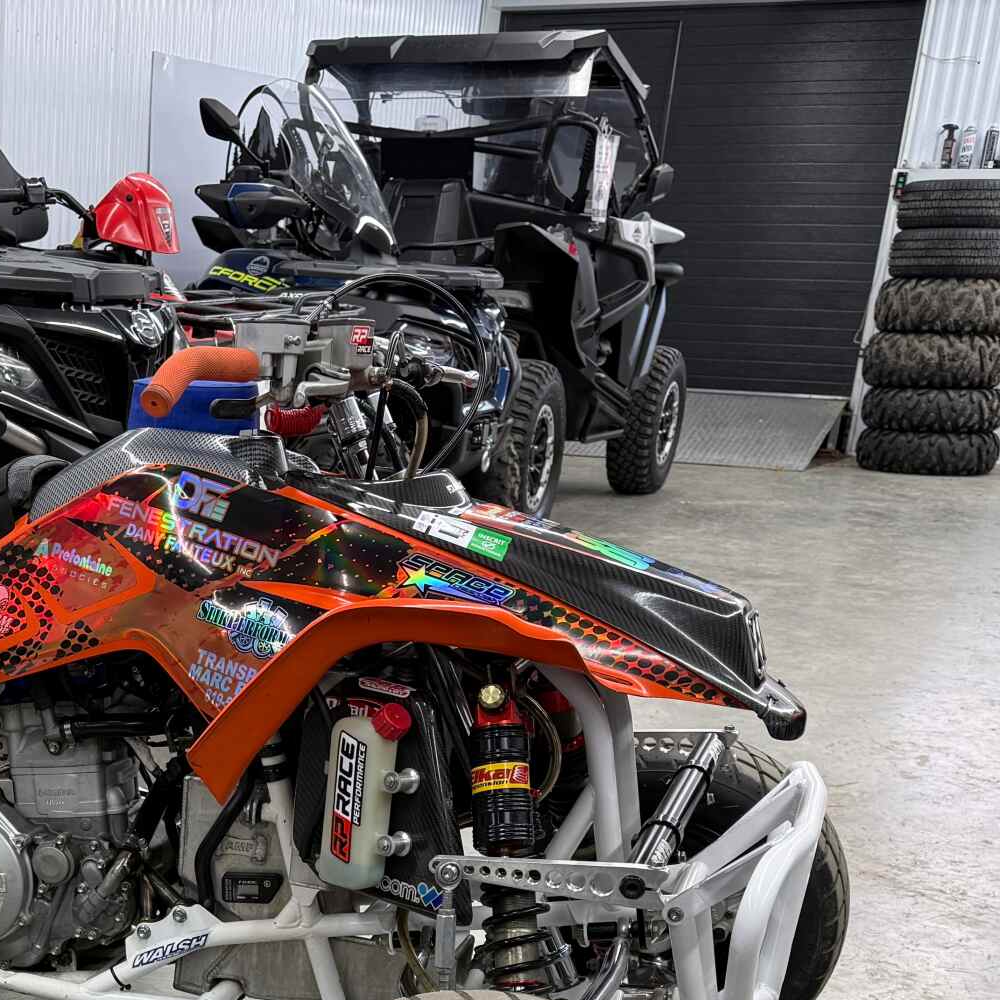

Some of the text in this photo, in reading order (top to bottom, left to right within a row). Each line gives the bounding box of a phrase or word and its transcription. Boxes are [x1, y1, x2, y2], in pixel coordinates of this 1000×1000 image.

[107, 497, 281, 567] FENESTRATION
[125, 522, 168, 550] DANY
[164, 535, 237, 572] FAUTEUX
[188, 662, 233, 693] MARC
[336, 732, 358, 819] RACE
[351, 743, 367, 826] PERFORMANCE
[333, 814, 352, 862] RP
[133, 932, 209, 968] WALSH
